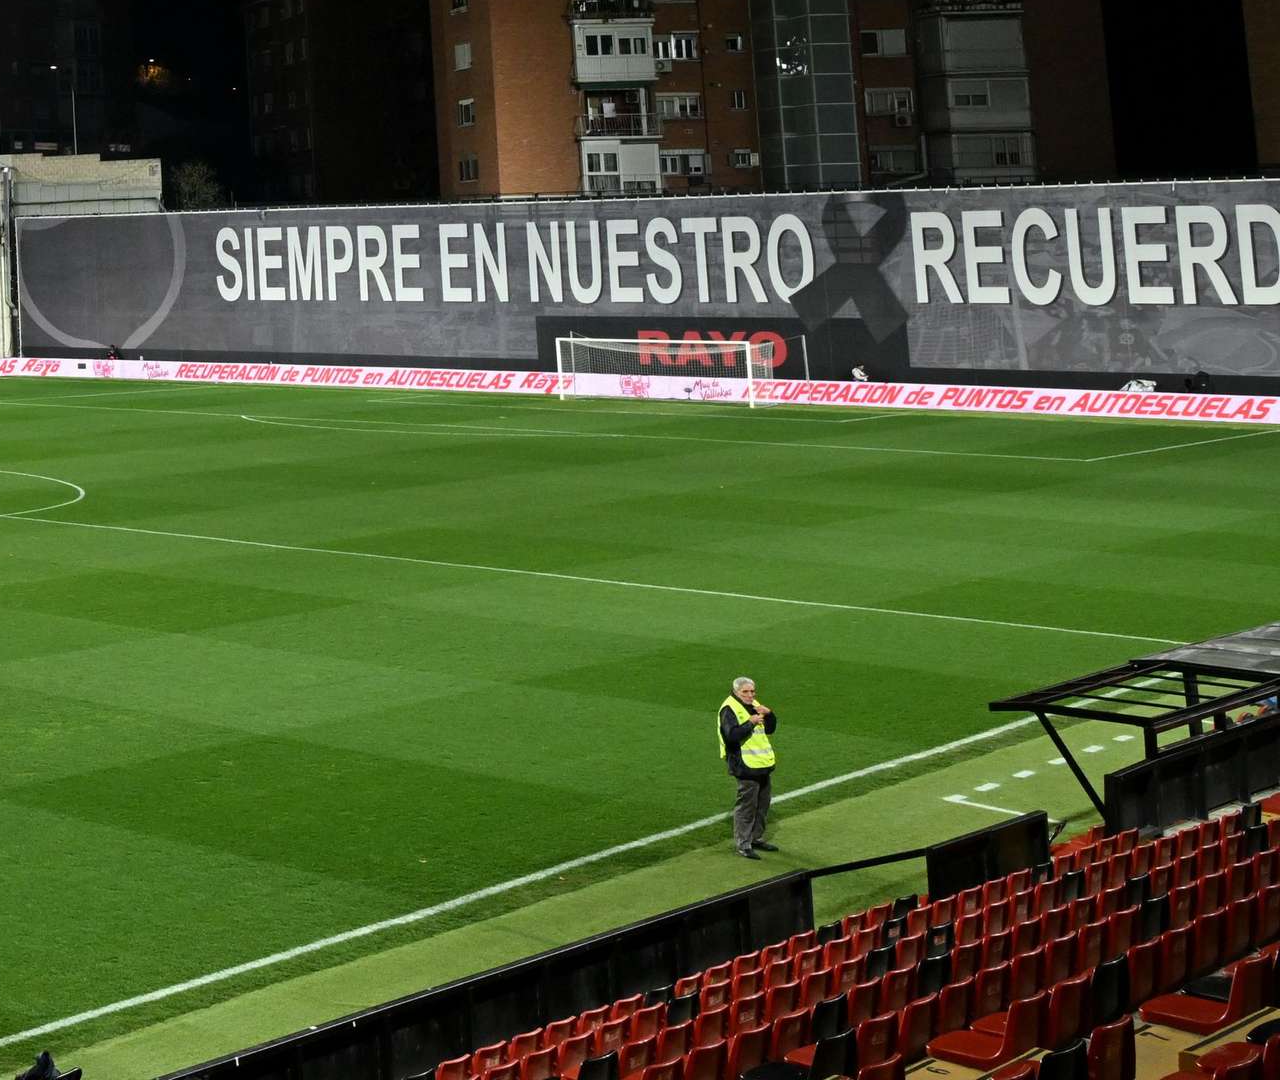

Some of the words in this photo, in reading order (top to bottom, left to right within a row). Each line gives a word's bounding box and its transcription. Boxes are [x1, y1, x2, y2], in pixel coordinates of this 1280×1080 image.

[215, 223, 425, 304] SIEMPRE
[440, 222, 509, 304] EN
[527, 213, 815, 305] NUESTRO
[910, 203, 1280, 307] RECUERD
[636, 329, 788, 369] RAYO
[21, 359, 60, 376] Rayo
[281, 366, 299, 382] de
[301, 367, 363, 384] PUNTOS
[362, 373, 383, 385] en
[385, 370, 512, 389] AUTOESCUELAS
[520, 372, 573, 393] Rayo
[903, 386, 934, 406] de
[936, 387, 1033, 409] PUNTOS
[1032, 394, 1067, 411] en
[1068, 392, 1278, 420] AUTOESCUELAS
